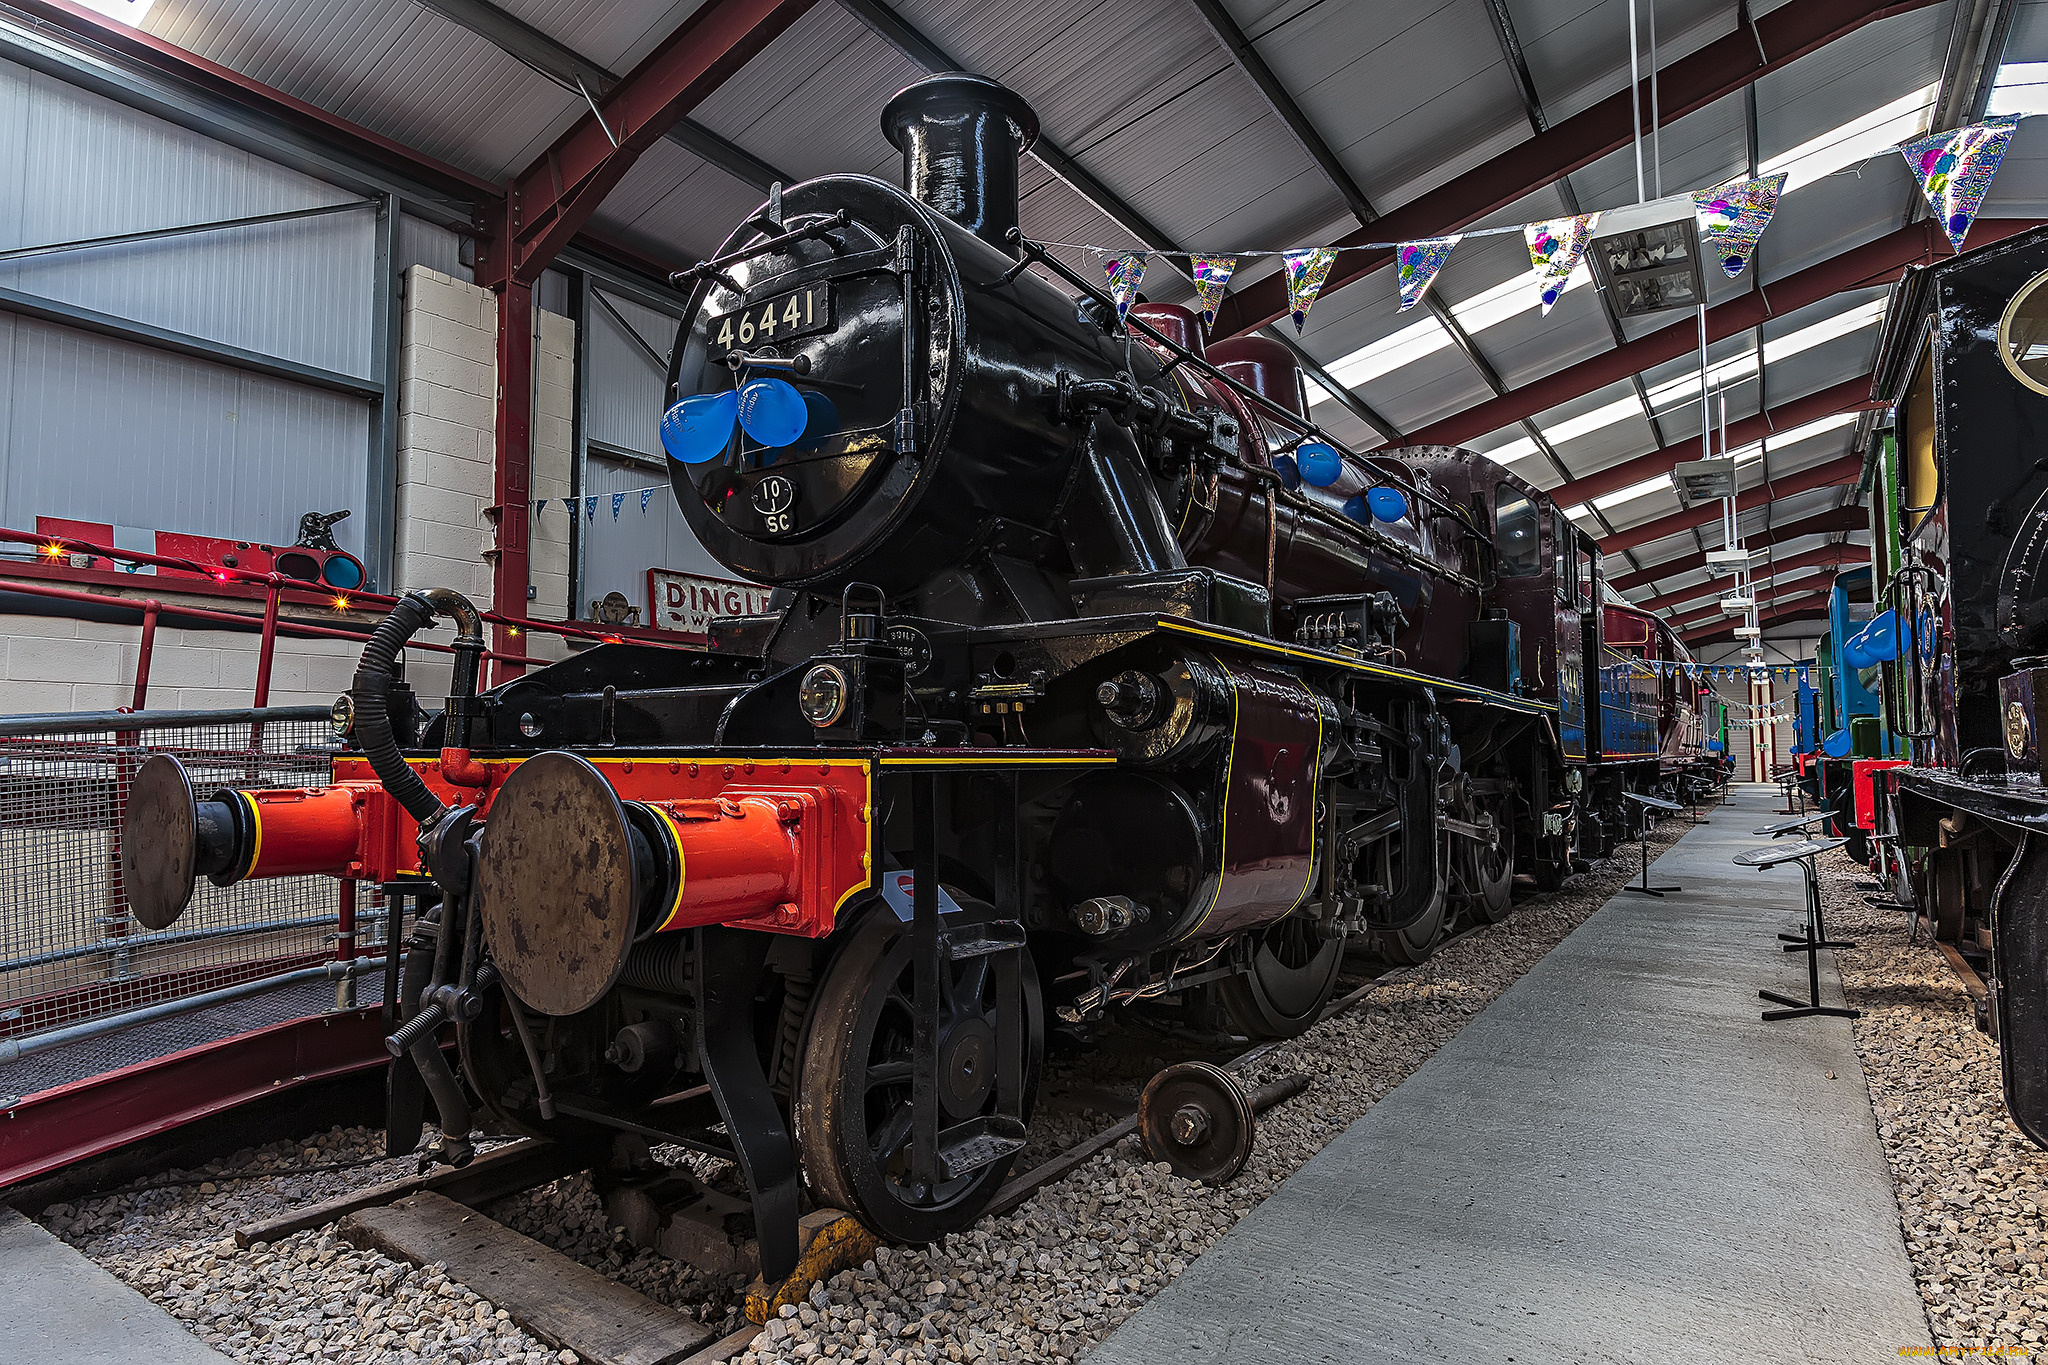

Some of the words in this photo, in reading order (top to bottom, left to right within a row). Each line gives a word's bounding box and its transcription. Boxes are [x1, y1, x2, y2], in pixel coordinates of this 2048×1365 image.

[1959, 132, 2009, 212] BIRTHDAY
[717, 290, 813, 350] 46441
[763, 480, 780, 499] 10
[767, 514, 789, 532] SC
